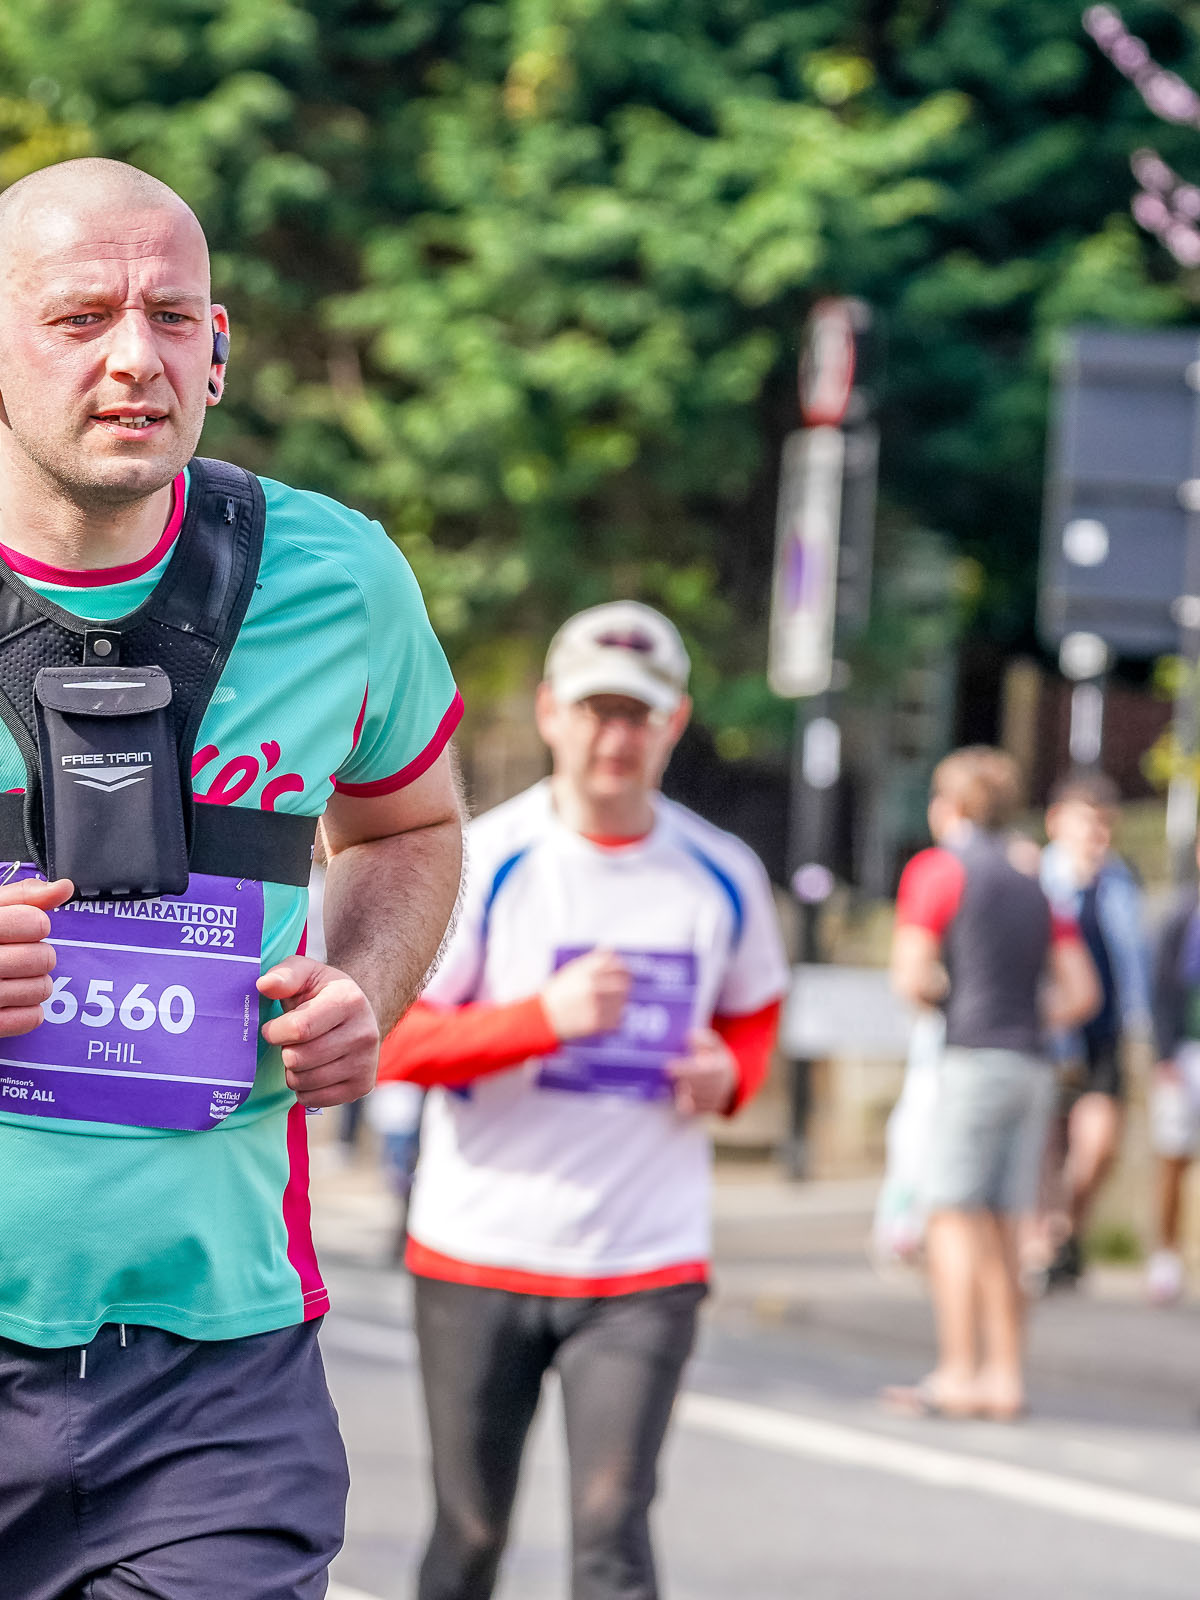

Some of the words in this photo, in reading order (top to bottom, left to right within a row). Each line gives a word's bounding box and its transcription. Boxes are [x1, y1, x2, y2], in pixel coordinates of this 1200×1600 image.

[61, 754, 104, 766] FREE
[106, 751, 152, 763] TRAIN
[116, 901, 235, 926] MARATHON
[180, 925, 235, 947] 2022
[40, 976, 196, 1034] 6560
[87, 1040, 143, 1064] PHIL
[2, 1085, 28, 1099] FOR
[31, 1089, 55, 1103] ALL
[212, 1090, 240, 1101] Sheffield
